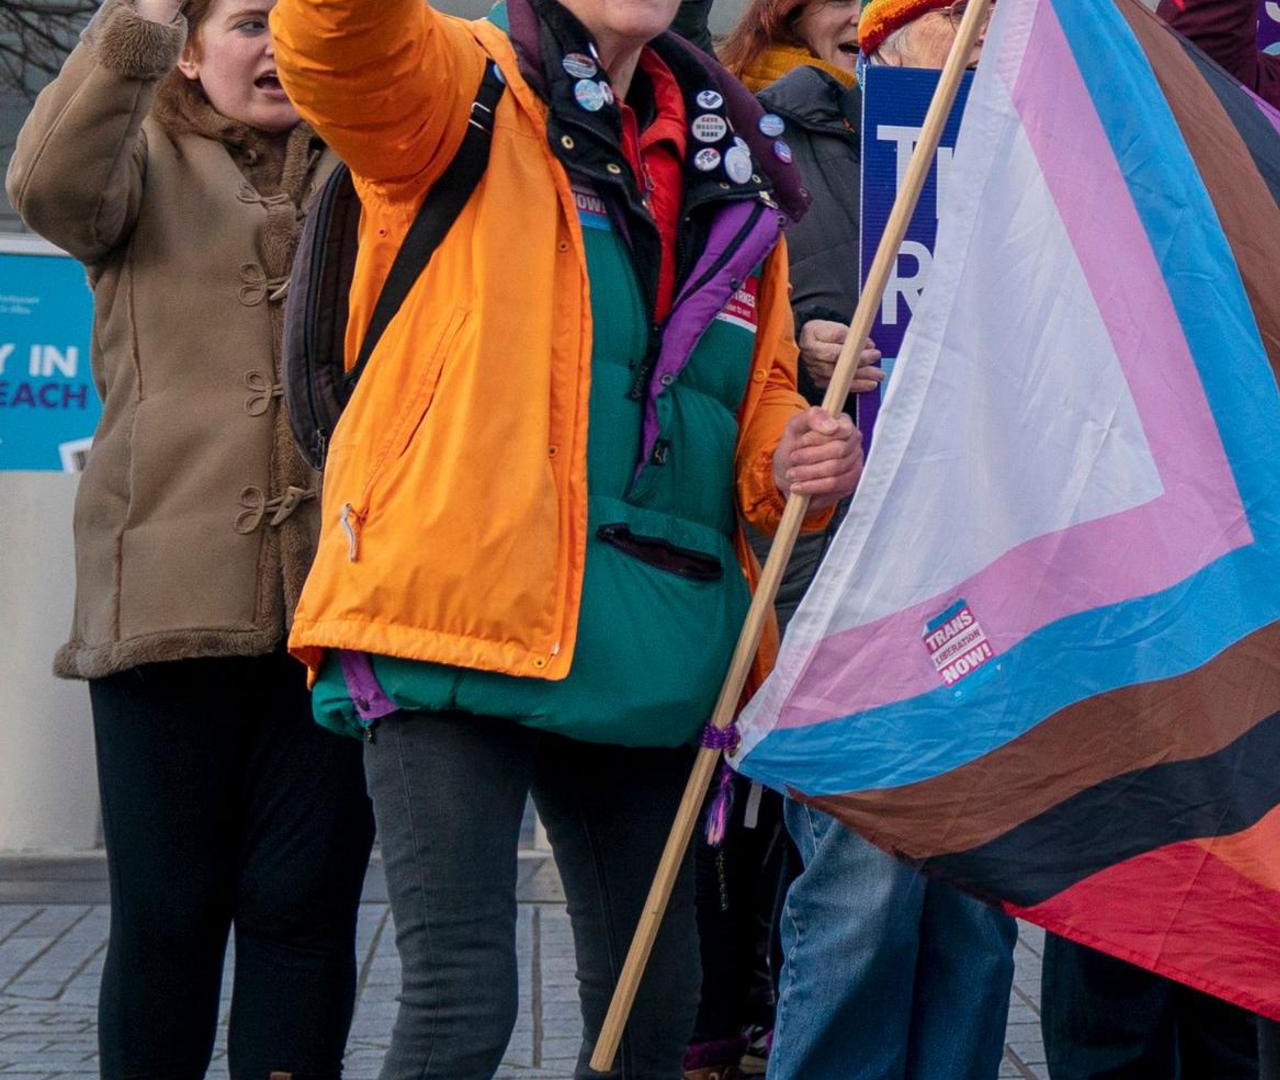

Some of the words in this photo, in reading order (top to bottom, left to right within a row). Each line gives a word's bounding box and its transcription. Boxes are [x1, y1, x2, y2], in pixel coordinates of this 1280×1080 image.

[28, 343, 78, 378] IN
[925, 609, 975, 650] TRANS
[941, 642, 992, 684] NOW!
